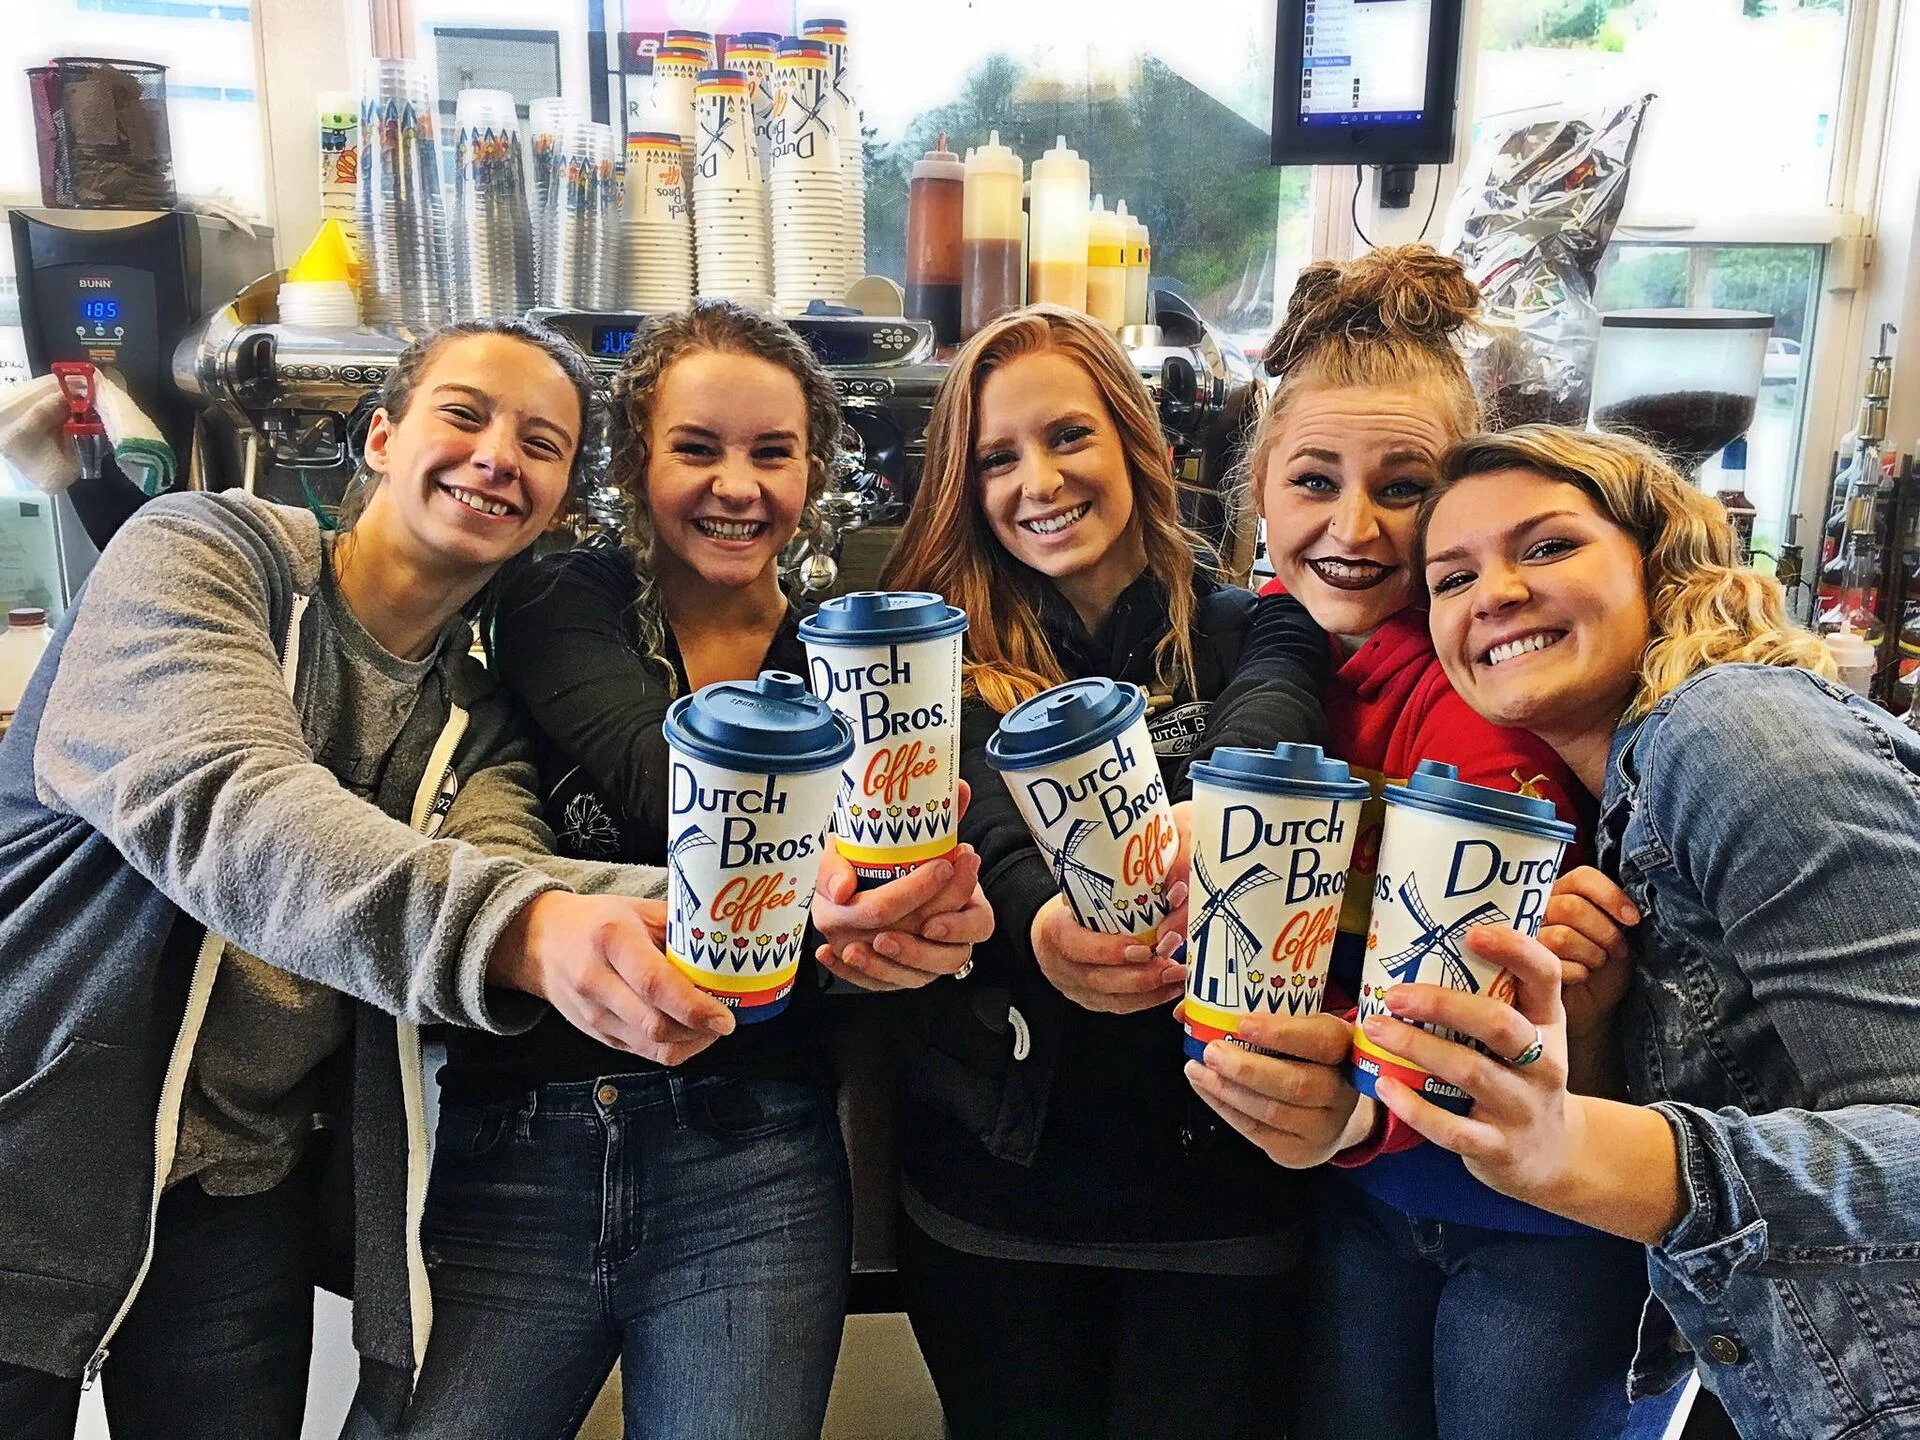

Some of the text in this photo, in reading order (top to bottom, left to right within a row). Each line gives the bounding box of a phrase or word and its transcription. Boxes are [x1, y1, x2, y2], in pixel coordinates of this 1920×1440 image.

[79, 279, 113, 288] BUNN
[87, 302, 117, 318] 185
[811, 646, 911, 702] DUTCH
[860, 691, 948, 745] BROS.
[1150, 721, 1188, 741] UTCH
[672, 762, 788, 815] DUTCH
[863, 740, 938, 804] Coffee
[1026, 737, 1136, 829] DUTCH
[719, 817, 815, 870] BROS.
[1220, 800, 1344, 864] DUTCH
[710, 872, 796, 933] Coffee
[1358, 1057, 1380, 1077] LARGE
